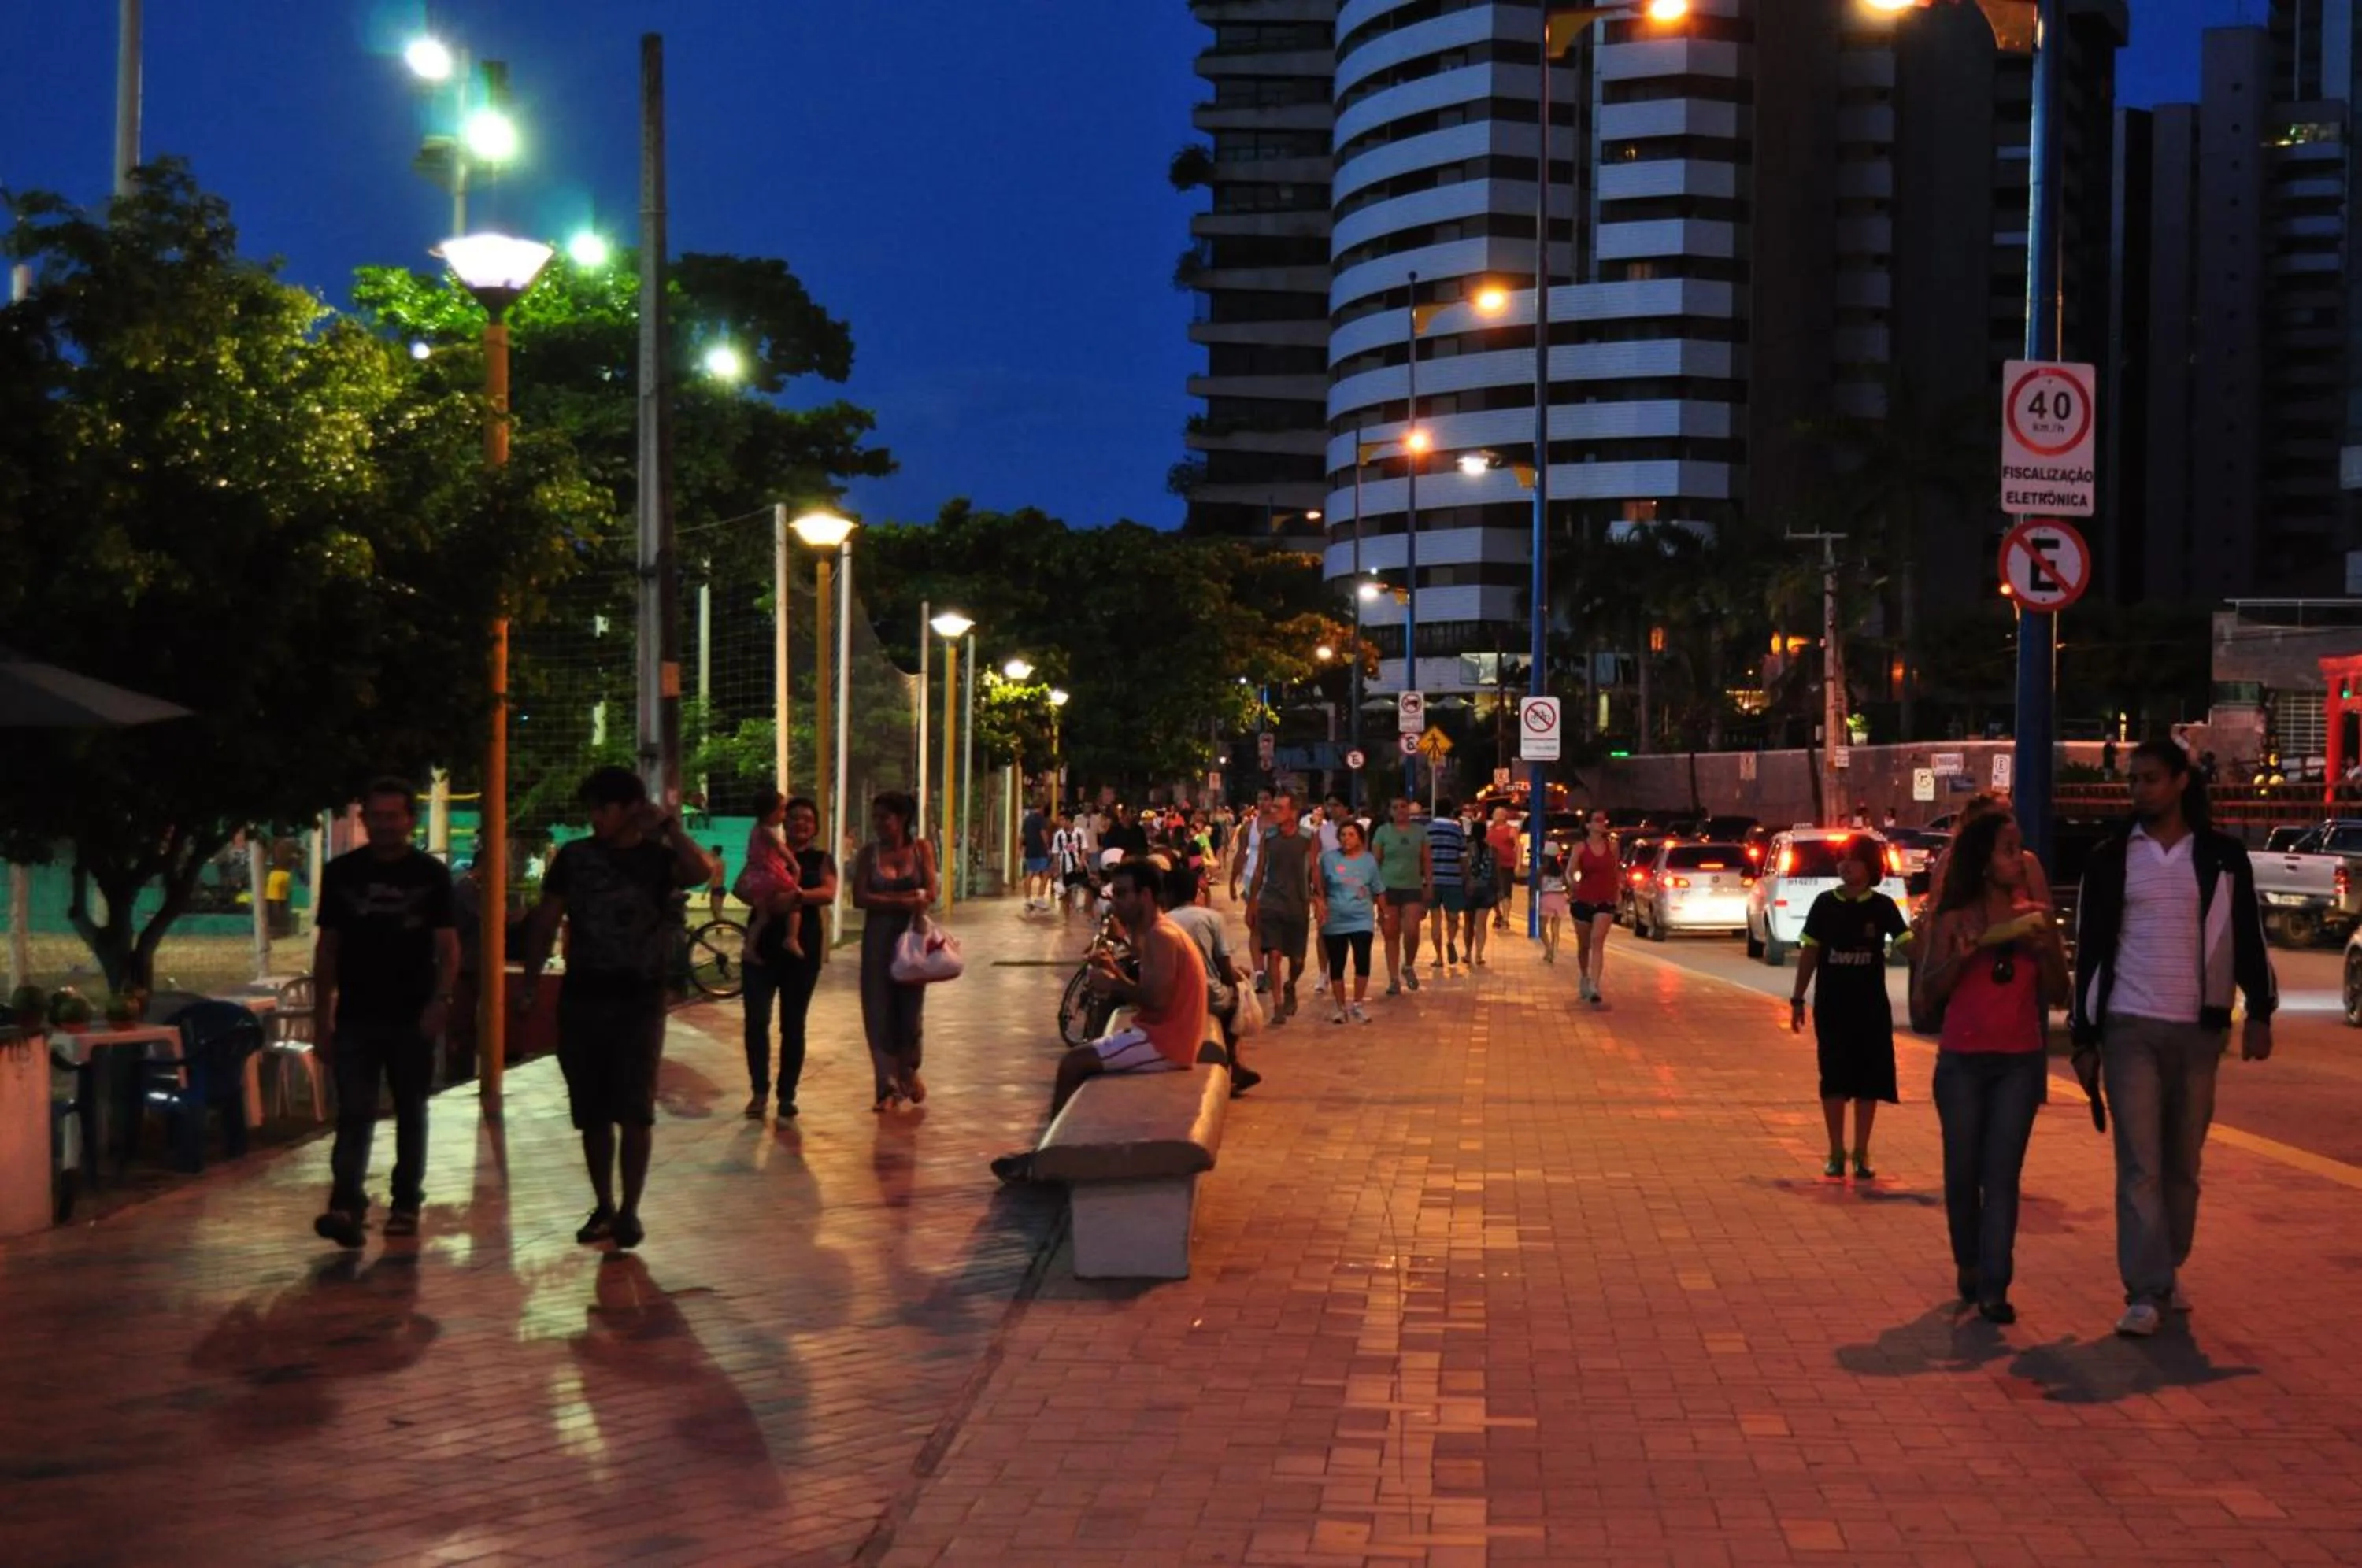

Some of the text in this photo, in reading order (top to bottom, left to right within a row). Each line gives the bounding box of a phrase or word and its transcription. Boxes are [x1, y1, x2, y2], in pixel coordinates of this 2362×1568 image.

[2028, 390, 2071, 420] 40
[2003, 465, 2093, 485] FISCALIZAÇÃO
[2006, 489, 2088, 507] ELETRÔNICA
[2031, 538, 2059, 592] E
[1828, 947, 1873, 965] bwin
